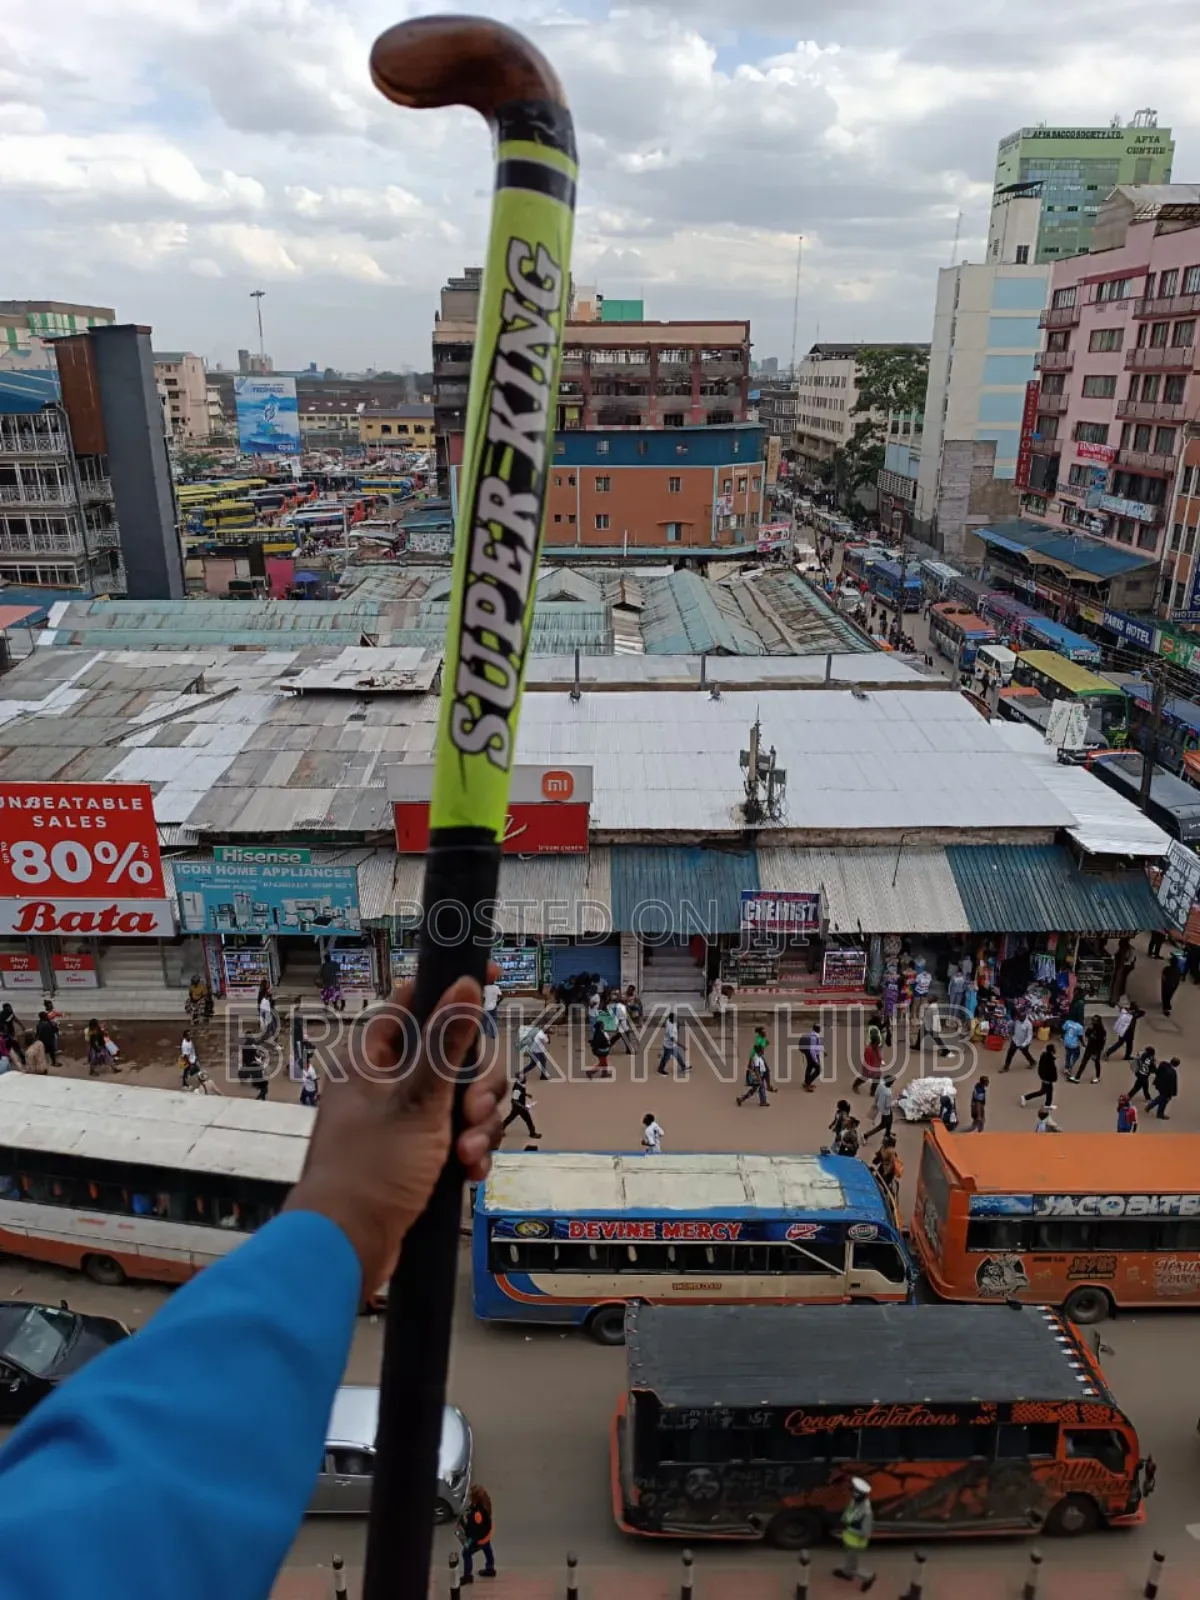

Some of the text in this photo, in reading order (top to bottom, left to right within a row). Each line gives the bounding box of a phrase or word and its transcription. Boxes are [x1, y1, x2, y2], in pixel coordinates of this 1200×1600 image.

[1126, 146, 1165, 154] CENTRE
[1019, 428, 1033, 484] HOTEL
[449, 236, 563, 773] SUPER KING
[1104, 613, 1124, 631] PARIS
[1126, 622, 1150, 645] HOTEL
[32, 815, 107, 828] SALES
[9, 840, 153, 884] 80%
[222, 848, 302, 864] Hisense
[176, 865, 351, 878] ICON HOME APPLIANCES
[12, 901, 158, 933] Bata
[744, 900, 817, 921] CHEMIST
[568, 1220, 742, 1240] DEVINE MERCY
[784, 1402, 960, 1436] Congratulations
